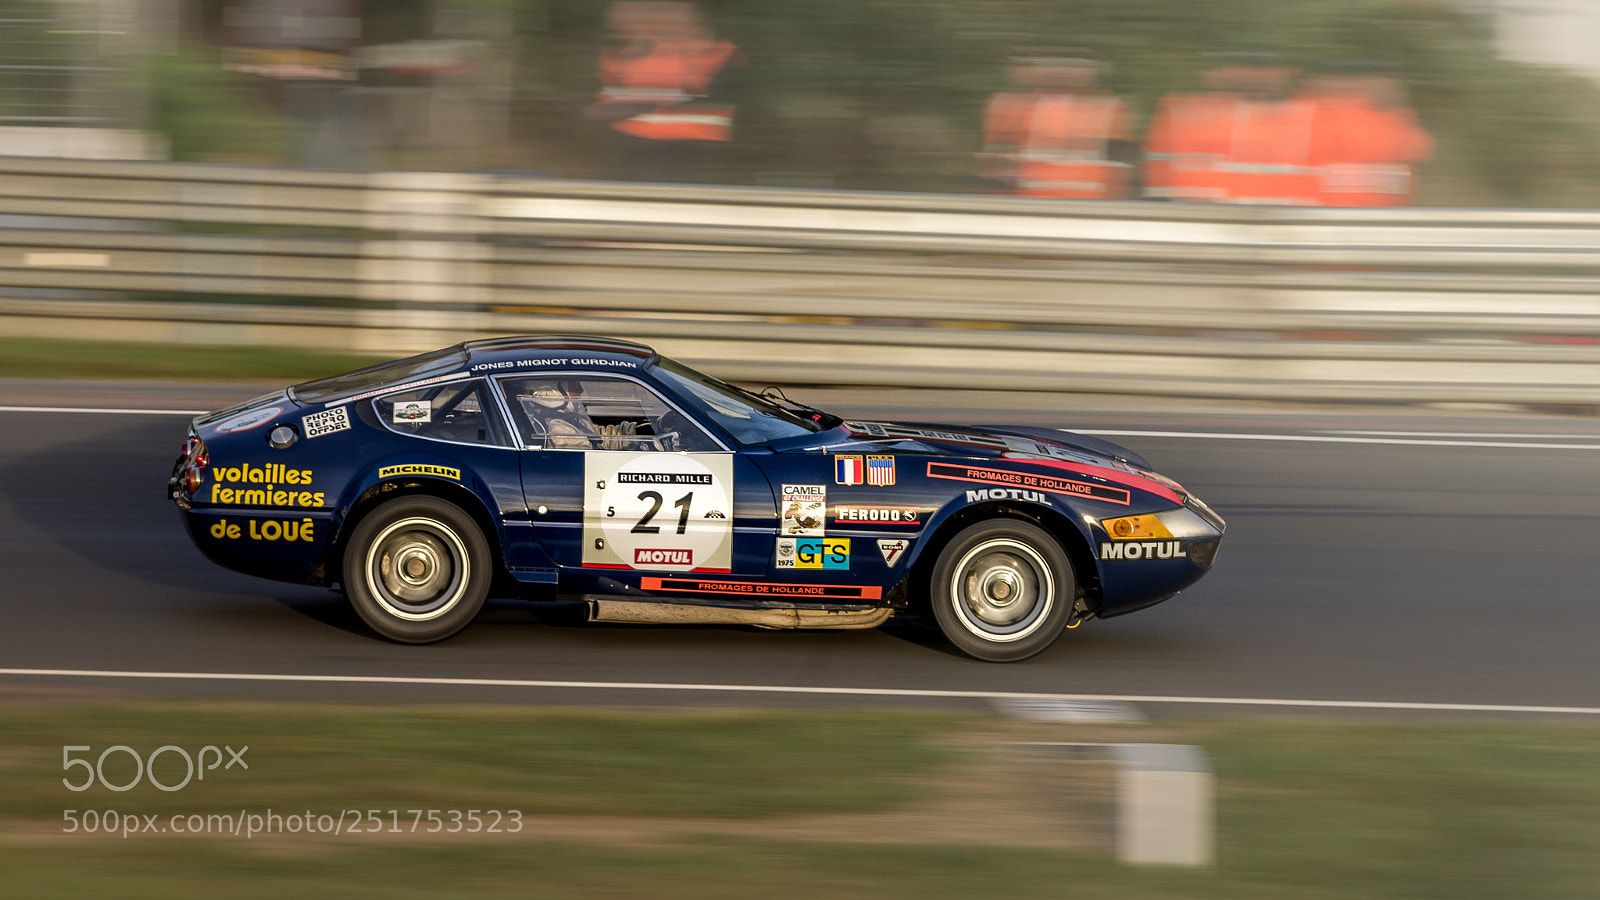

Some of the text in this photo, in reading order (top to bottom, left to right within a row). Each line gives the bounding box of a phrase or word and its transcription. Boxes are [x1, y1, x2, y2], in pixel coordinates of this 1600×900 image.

[471, 358, 637, 371] JONES MIGNOT GURDJIAN
[306, 408, 343, 422] PHOTO
[307, 414, 345, 428] REPRO
[212, 463, 313, 485] volailles
[382, 466, 457, 477] MICHELIN
[620, 474, 671, 483] RICHARD
[967, 470, 1091, 494] FROMAGES DE HOLLANDE
[211, 483, 325, 507] fermieres
[784, 486, 825, 495] CAMEL
[965, 489, 1053, 506] MOTUL
[606, 506, 616, 517] 5
[630, 490, 694, 535] 21
[839, 509, 900, 520] FERODO
[210, 519, 242, 539] de
[637, 551, 690, 563] MOTUL
[798, 544, 847, 564] GTS
[1101, 541, 1186, 559] MOTUL
[698, 583, 753, 592] FROMAGES
[772, 586, 824, 594] HOLLANDE
